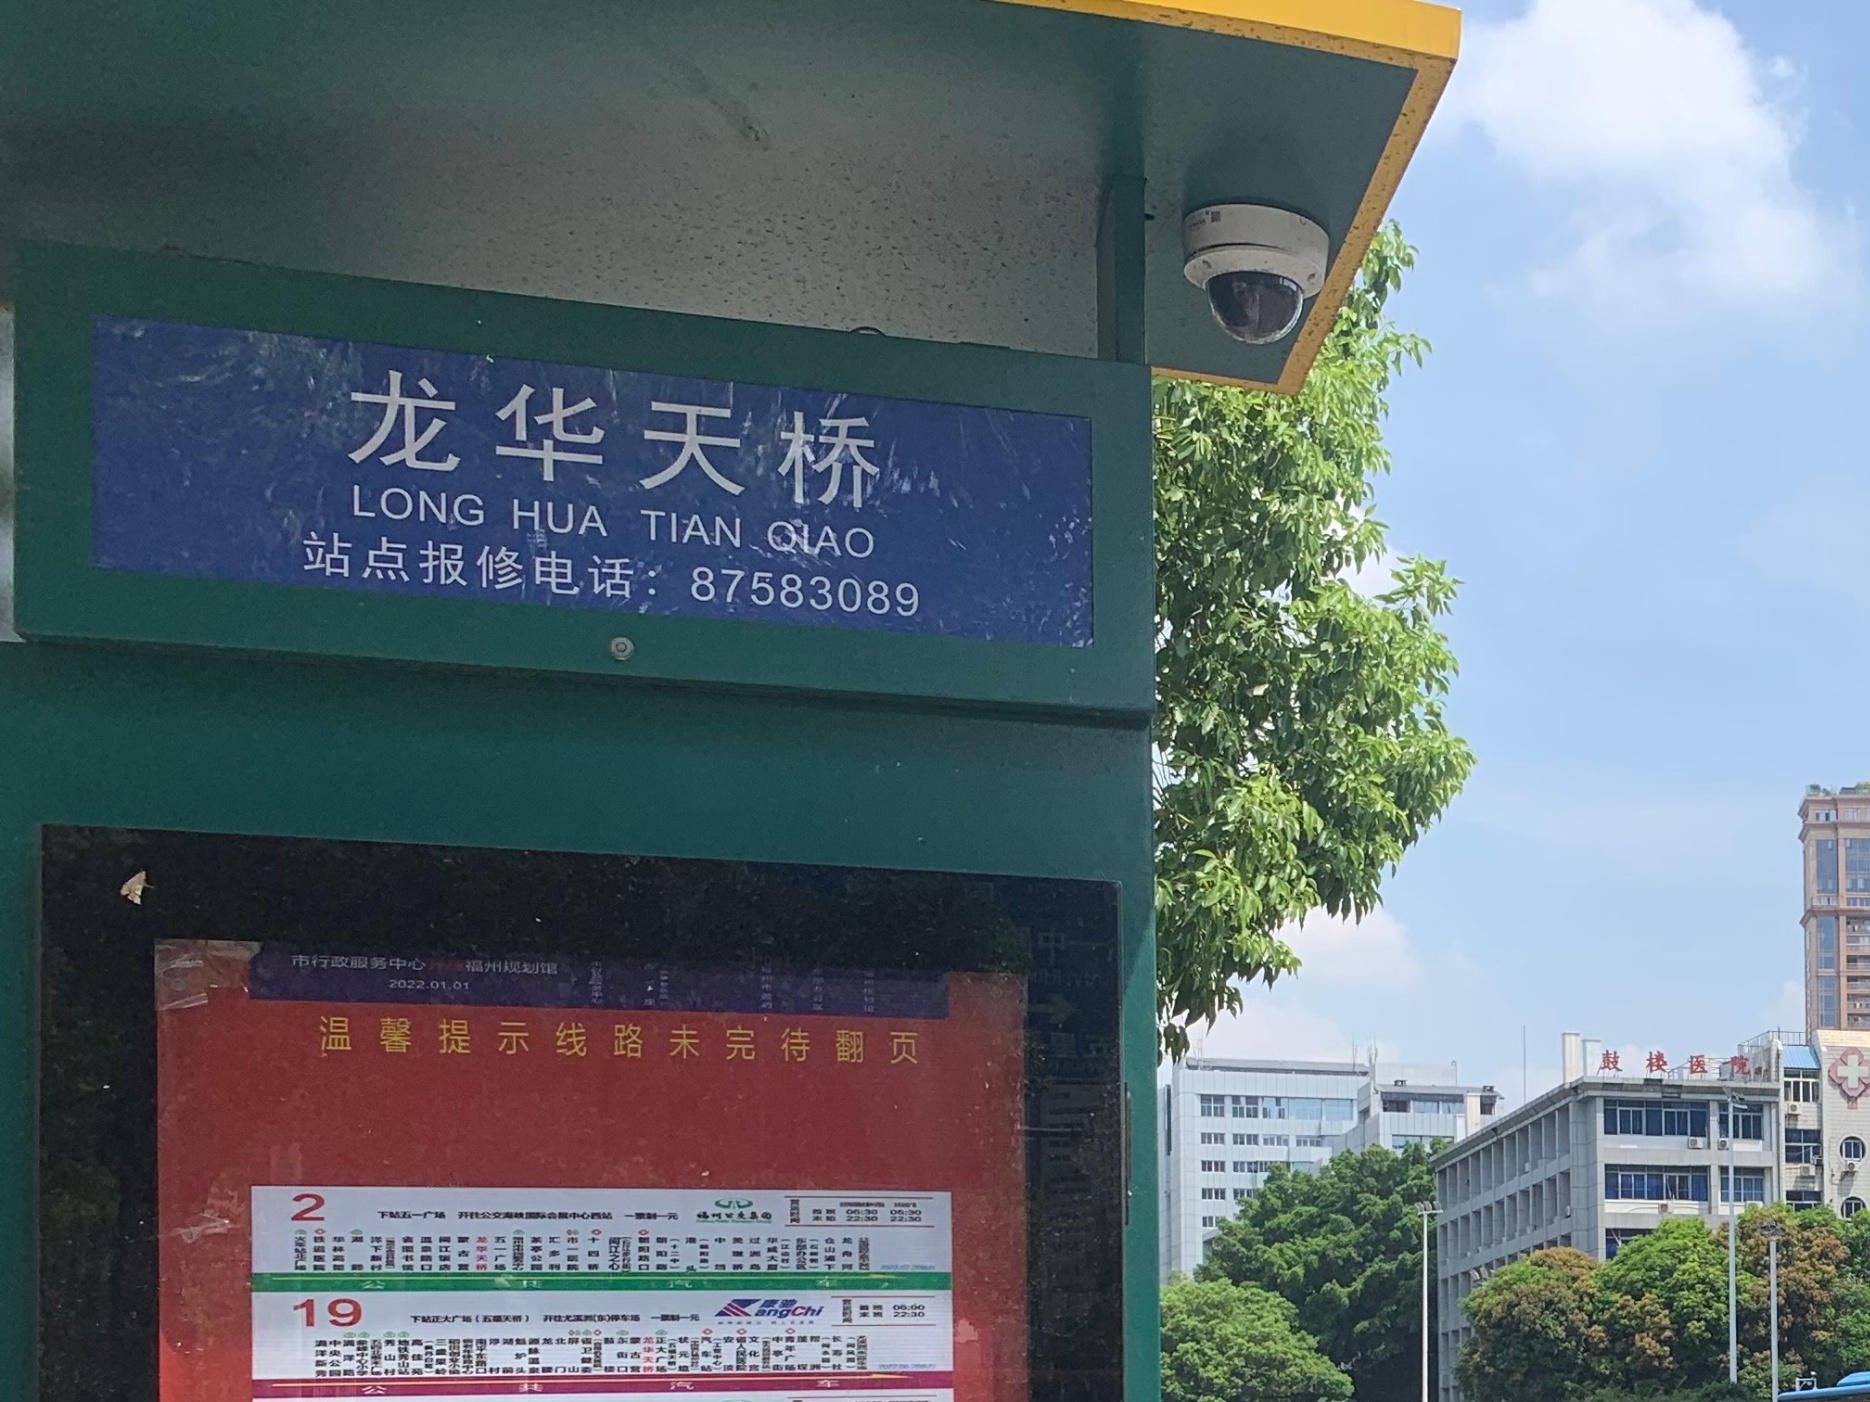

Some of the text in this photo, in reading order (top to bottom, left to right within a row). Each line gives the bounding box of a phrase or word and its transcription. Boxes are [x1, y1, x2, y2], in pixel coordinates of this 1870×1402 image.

[350, 370, 880, 508] 龙华天桥
[352, 484, 873, 561] LONG HUA TIAN QIAO
[303, 530, 920, 618] 站点报修电话: 87583089
[291, 954, 559, 976] 市行政服务中心 福州规划馆
[388, 977, 470, 992] 2022.01.01
[318, 1013, 920, 1068] 温馨提示线路未完待翻页
[1601, 1050, 1749, 1076] 鼓楼医院
[290, 1193, 324, 1221] 2
[377, 1210, 445, 1219] 下站五一广场
[293, 1298, 362, 1328] 19
[642, 1337, 654, 1373] 龙华天桥
